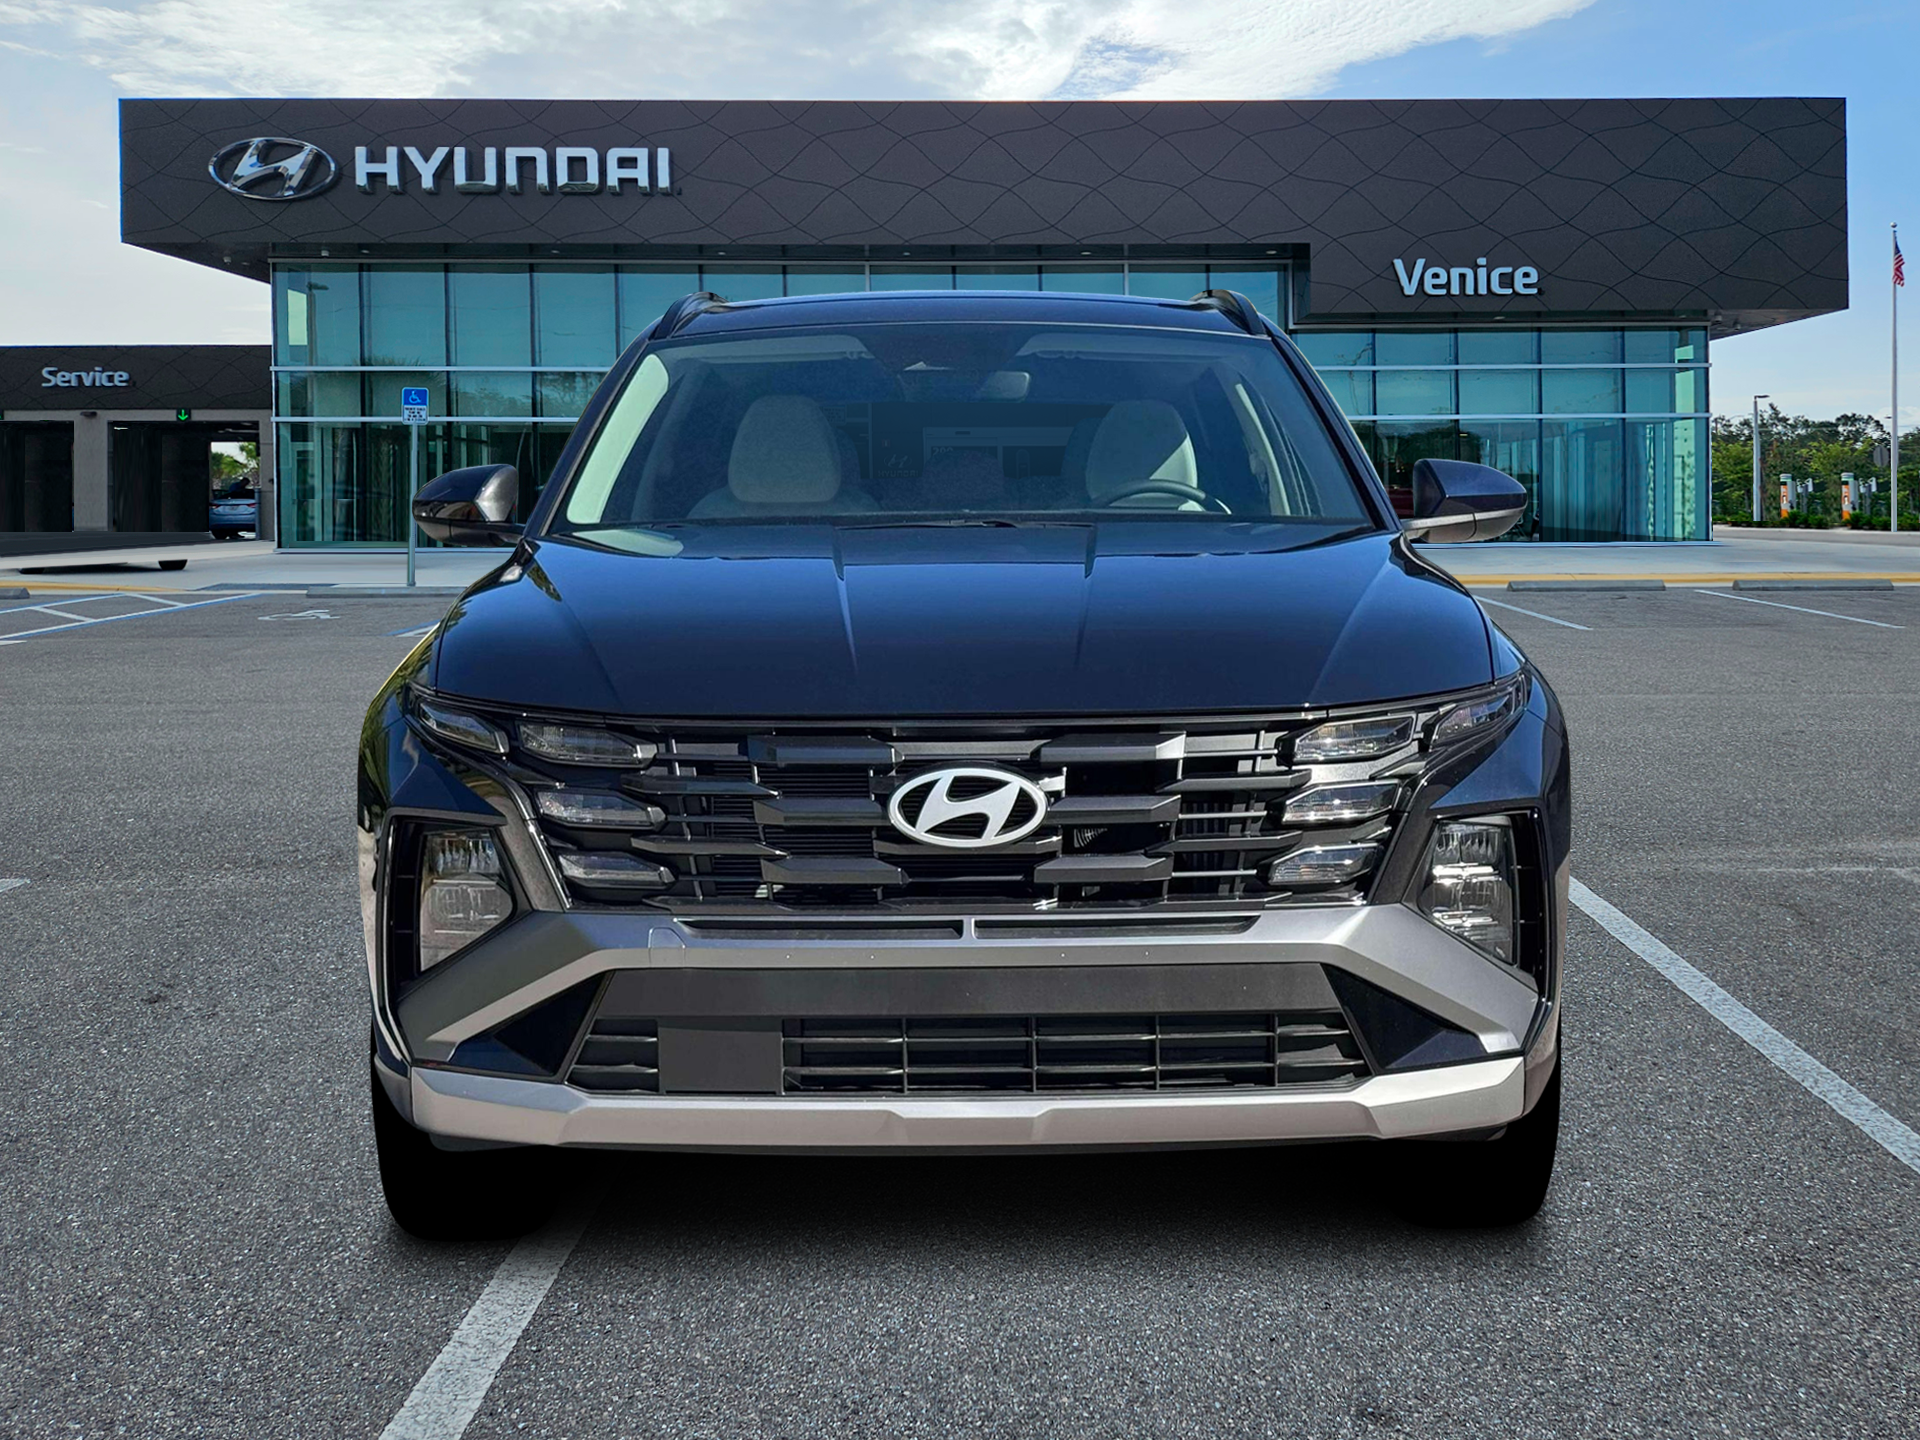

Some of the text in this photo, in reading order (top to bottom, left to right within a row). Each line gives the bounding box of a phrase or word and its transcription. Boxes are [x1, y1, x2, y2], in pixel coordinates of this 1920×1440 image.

[354, 146, 673, 194] HYUNDAI
[1393, 257, 1539, 296] Venice
[41, 366, 130, 387] Service
